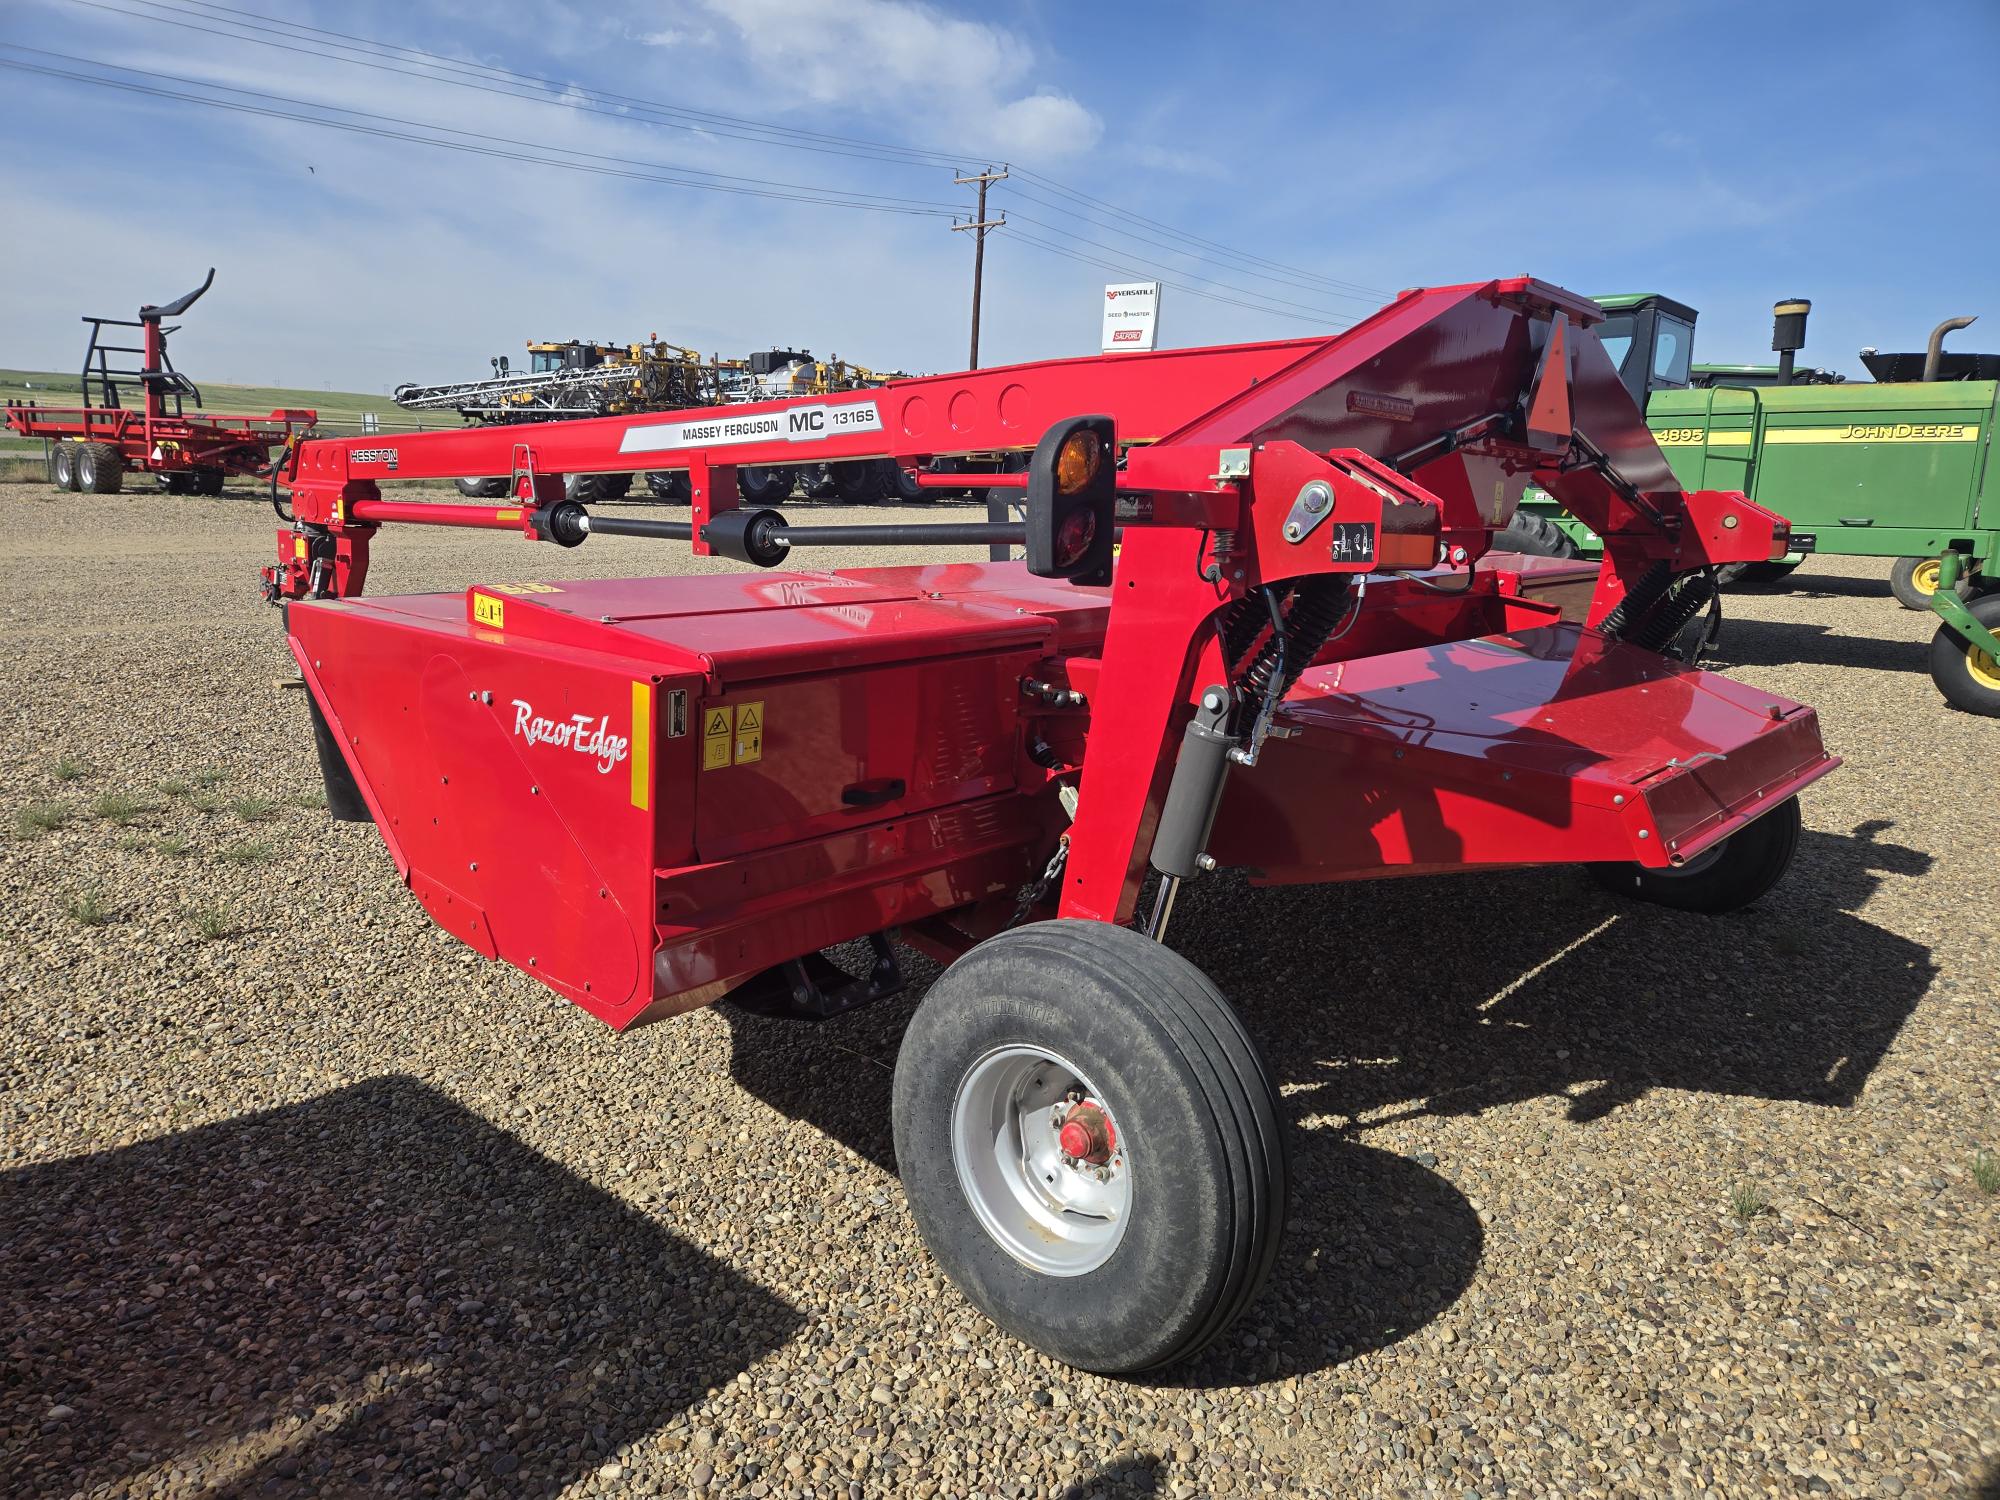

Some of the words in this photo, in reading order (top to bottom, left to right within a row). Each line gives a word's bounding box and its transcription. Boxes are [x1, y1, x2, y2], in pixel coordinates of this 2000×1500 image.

[1117, 289, 1155, 297] VERSATILE
[682, 425, 722, 441] MASSEY
[724, 419, 779, 437] FERGUSON
[789, 410, 825, 433] MC
[832, 409, 875, 426] 1316S
[1840, 424, 1894, 439] JOHN
[1895, 424, 1963, 438] DEERE
[1657, 428, 1705, 442] 4895
[350, 448, 398, 463] HESSTON
[511, 699, 628, 774] RazorEdge
